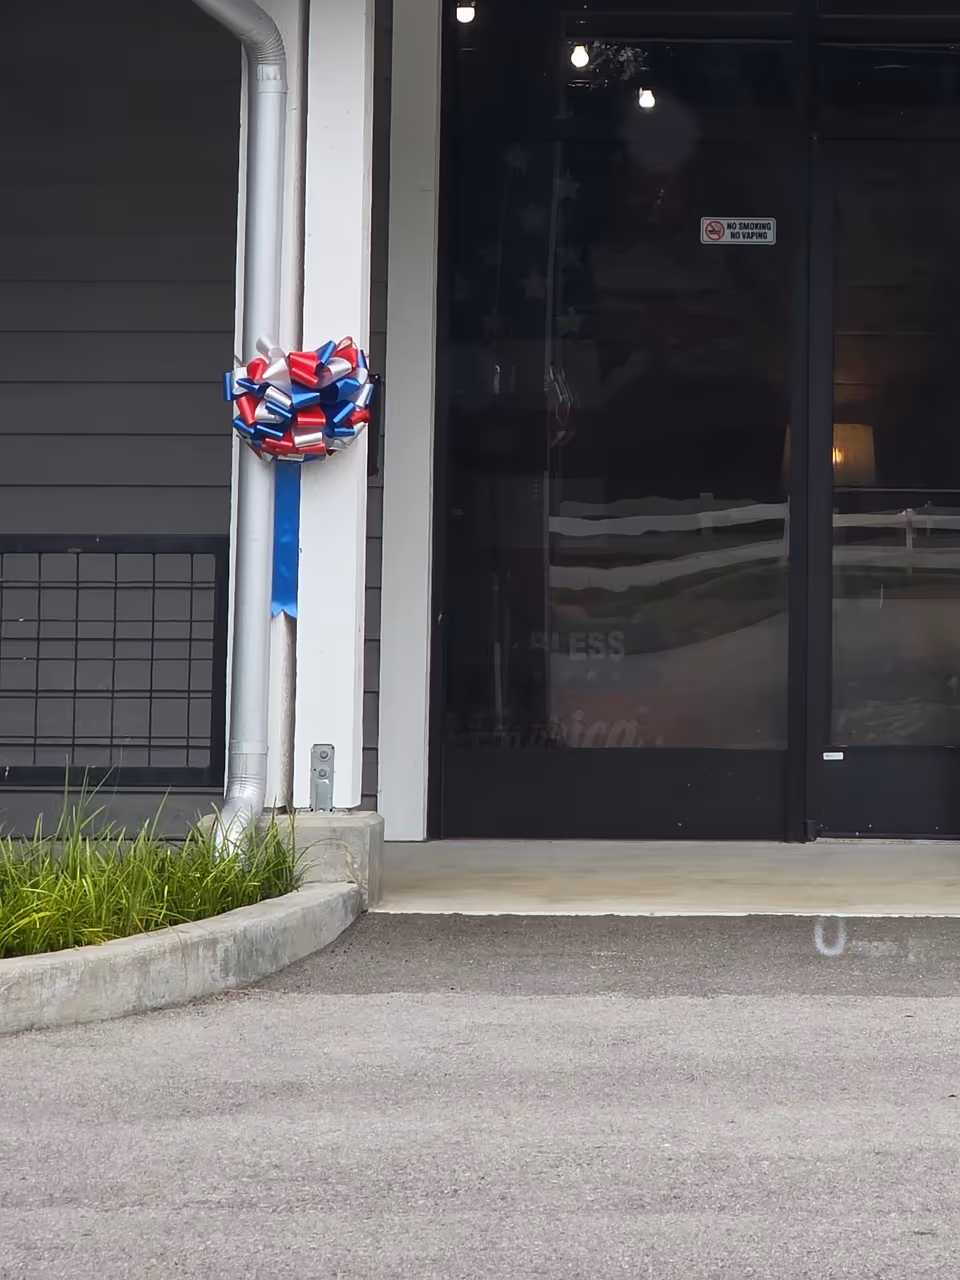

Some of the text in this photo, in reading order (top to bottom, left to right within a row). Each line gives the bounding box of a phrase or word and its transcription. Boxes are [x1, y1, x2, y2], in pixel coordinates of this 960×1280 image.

[727, 222, 772, 231] NO SMOKING
[730, 231, 768, 240] NO VAPING
